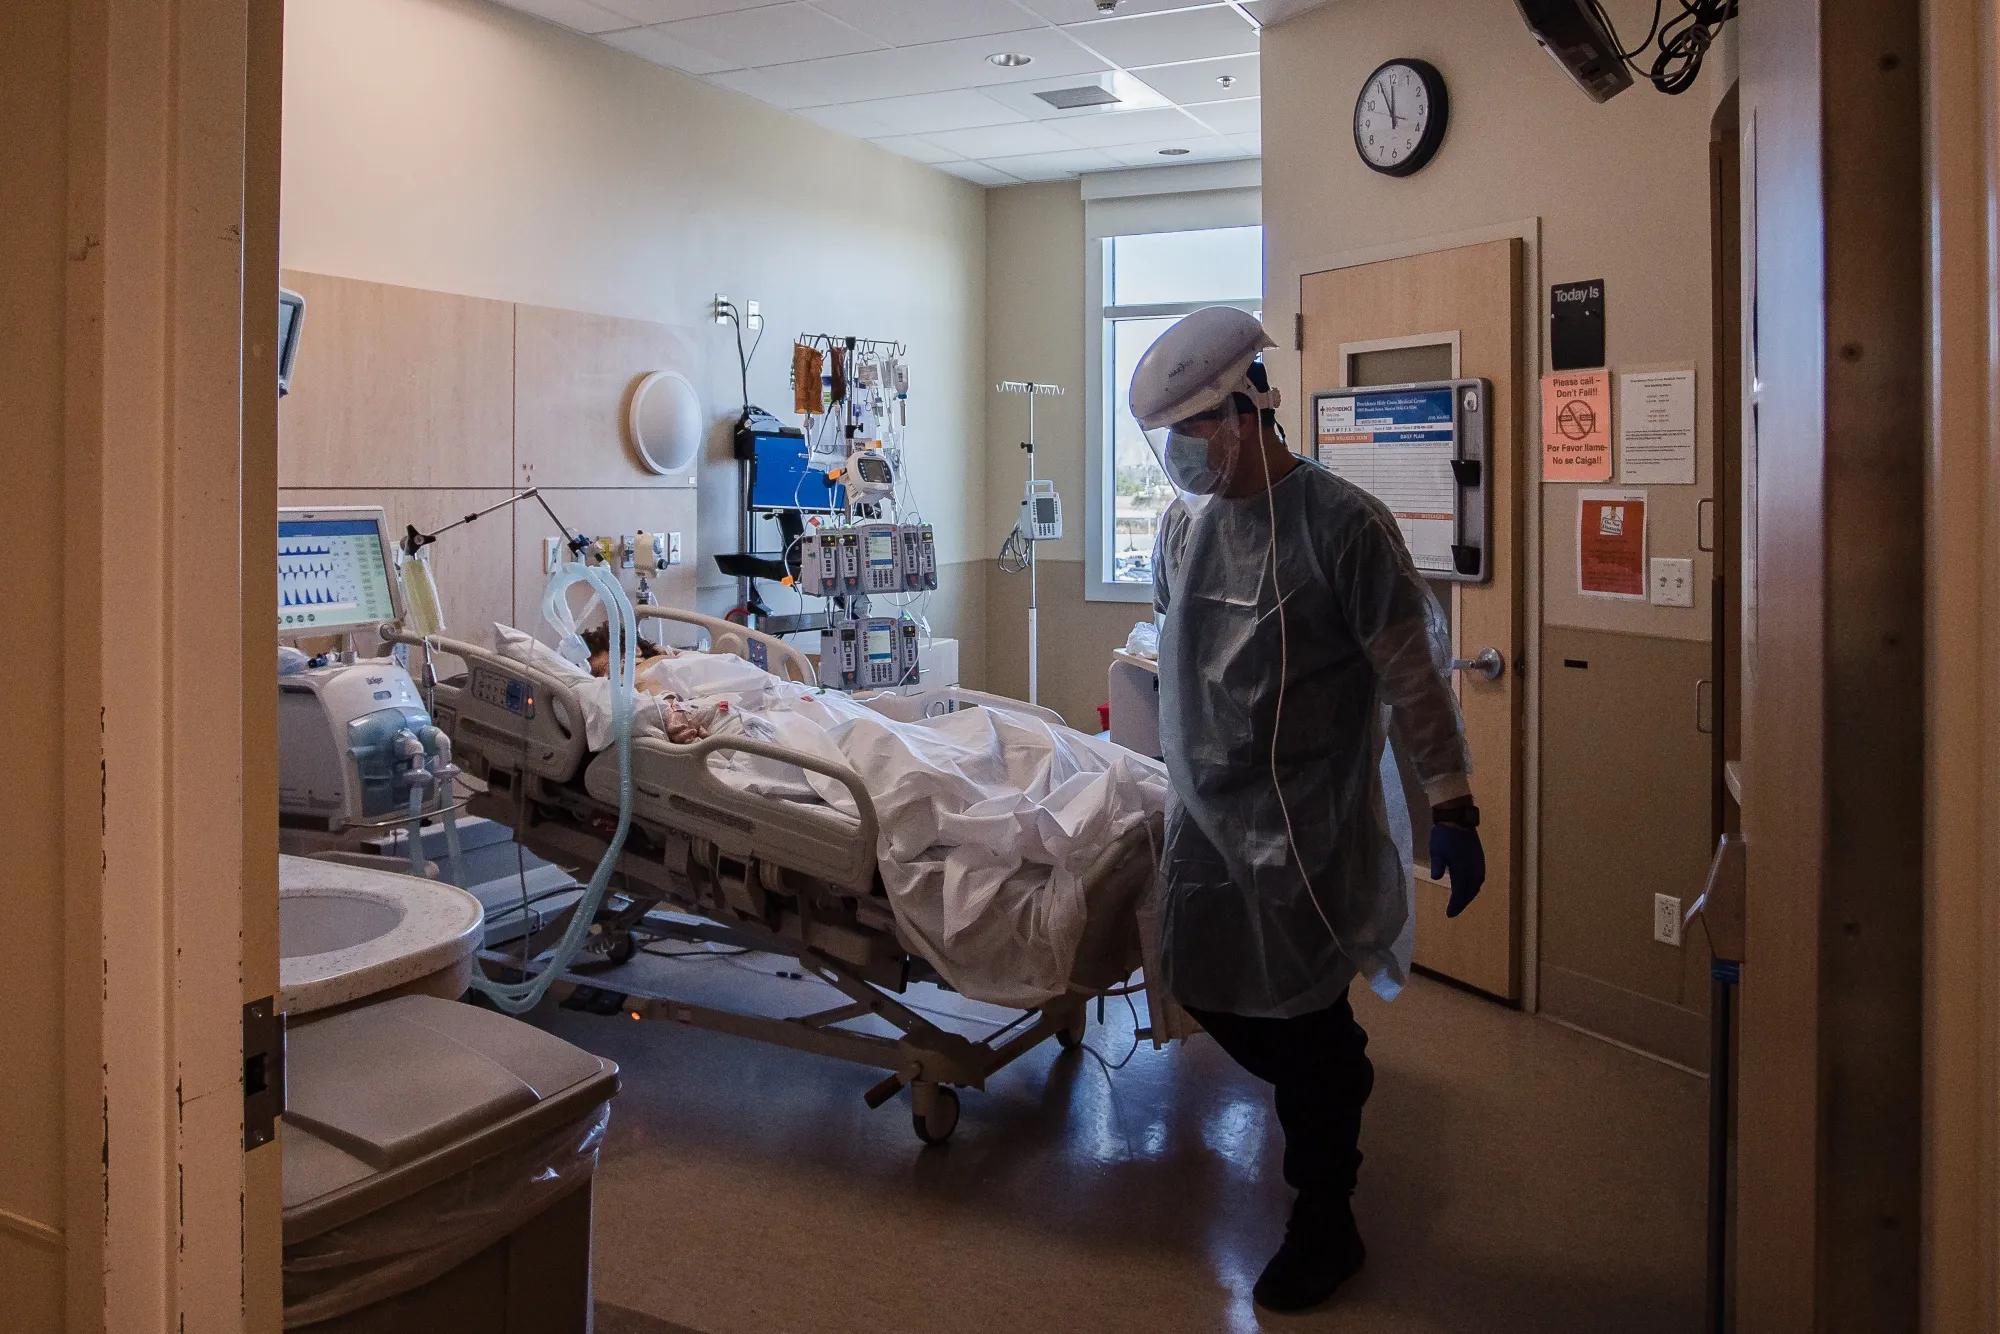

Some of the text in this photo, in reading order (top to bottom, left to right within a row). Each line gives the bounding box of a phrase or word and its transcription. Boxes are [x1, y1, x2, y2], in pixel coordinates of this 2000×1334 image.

[1389, 74, 1397, 85] 12
[1416, 86, 1421, 98] 2
[1367, 100, 1376, 112] 10
[1418, 104, 1424, 116] 3
[1365, 119, 1370, 129] 9
[1414, 122, 1420, 132] 4
[1369, 134, 1374, 145] 8
[1406, 139, 1412, 150] 5
[1380, 146, 1384, 156] 7
[1392, 148, 1398, 158] 6
[1555, 286, 1600, 303] Today Is
[1552, 378, 1578, 387] Please
[1580, 376, 1594, 385] call
[1556, 388, 1598, 398] Don't Fall!!
[1562, 444, 1583, 452] Favor
[1552, 456, 1563, 465] No
[1575, 456, 1602, 466] Caiga!!
